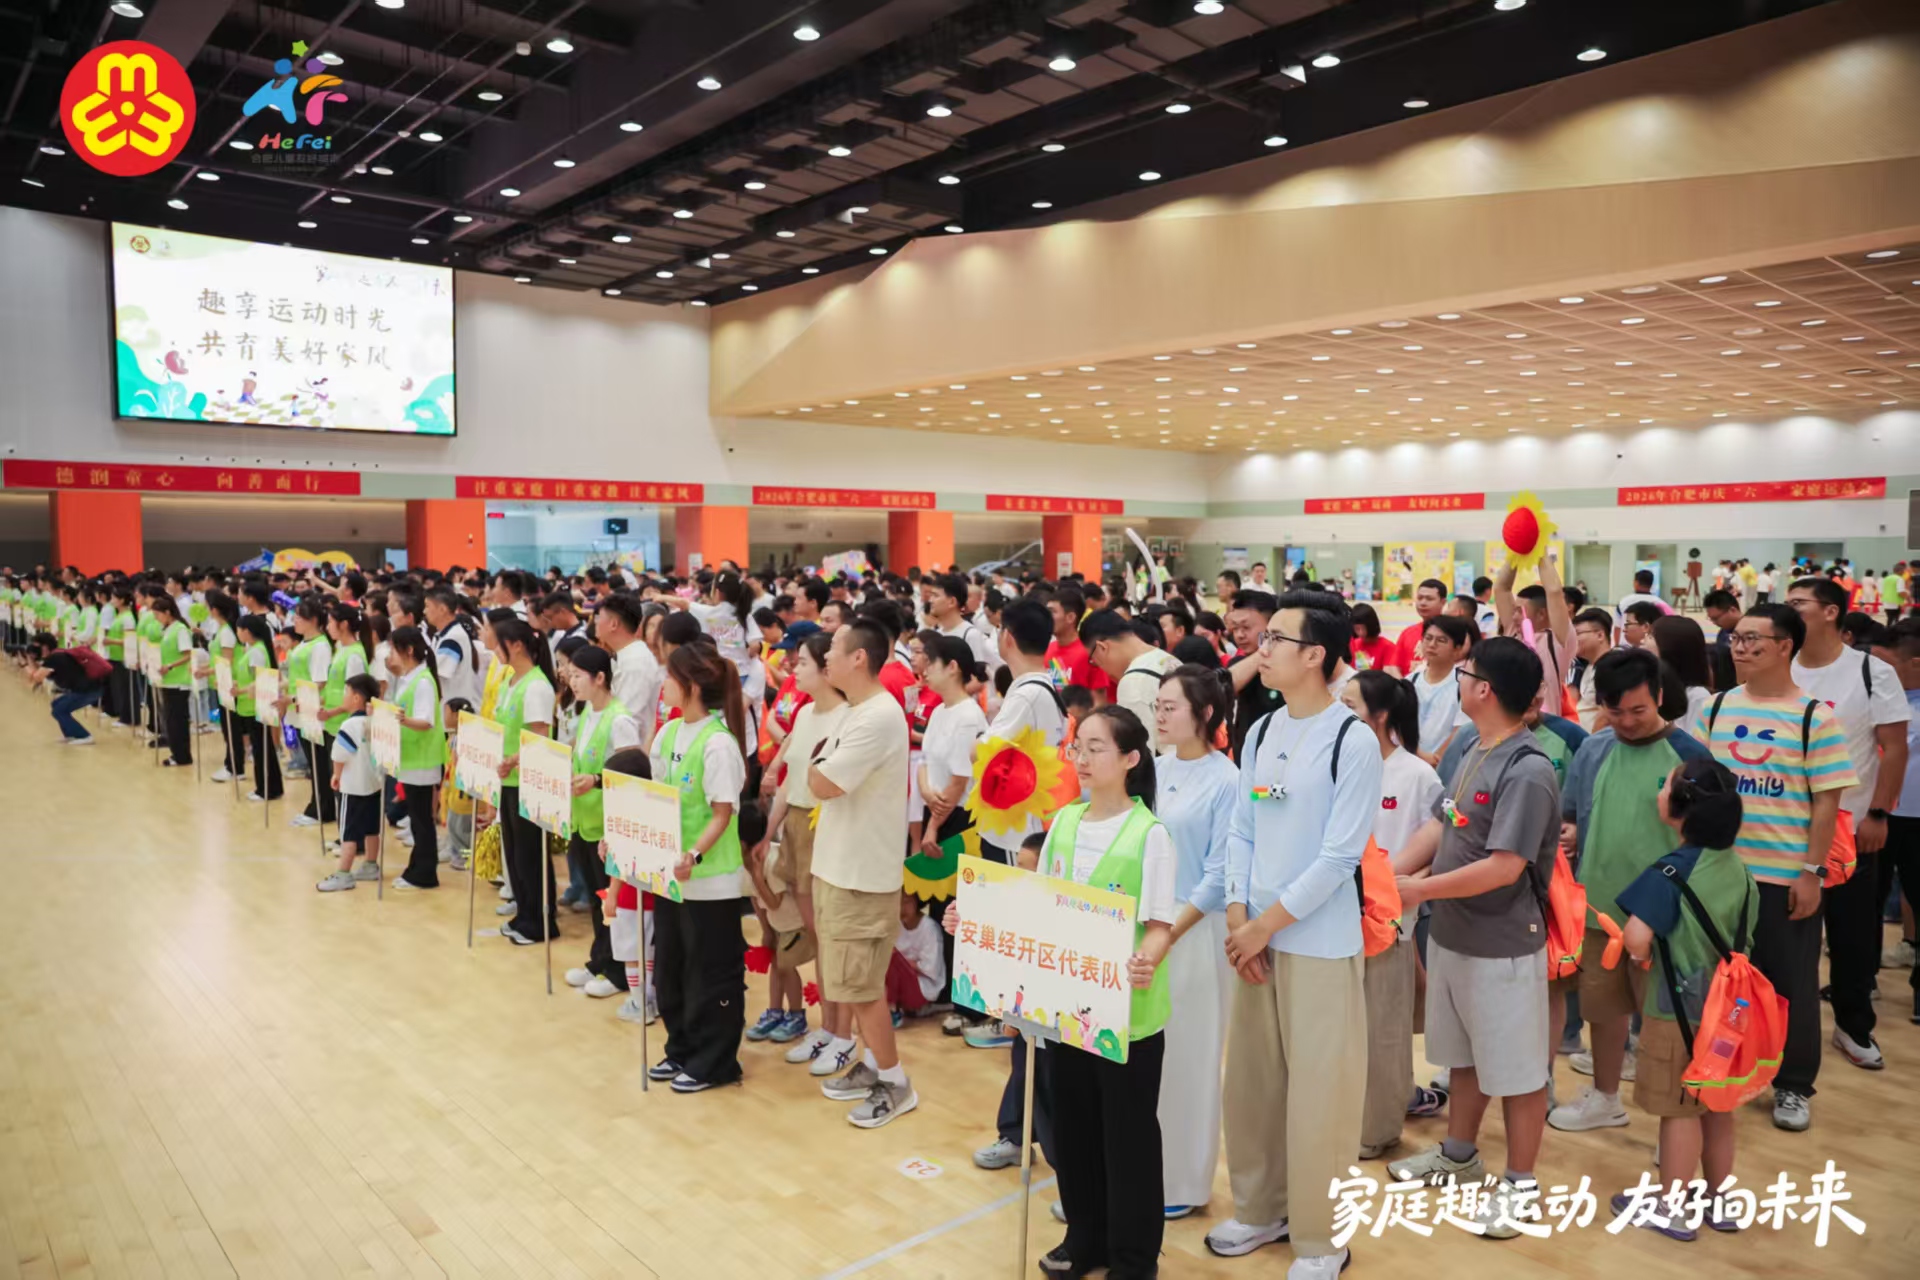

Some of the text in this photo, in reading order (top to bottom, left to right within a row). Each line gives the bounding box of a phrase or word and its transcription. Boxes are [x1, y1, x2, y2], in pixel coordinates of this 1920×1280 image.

[197, 288, 391, 332] 趣享运动时光
[197, 330, 392, 370] 共育美好家风
[960, 919, 1122, 991] 安巢经开区代表队
